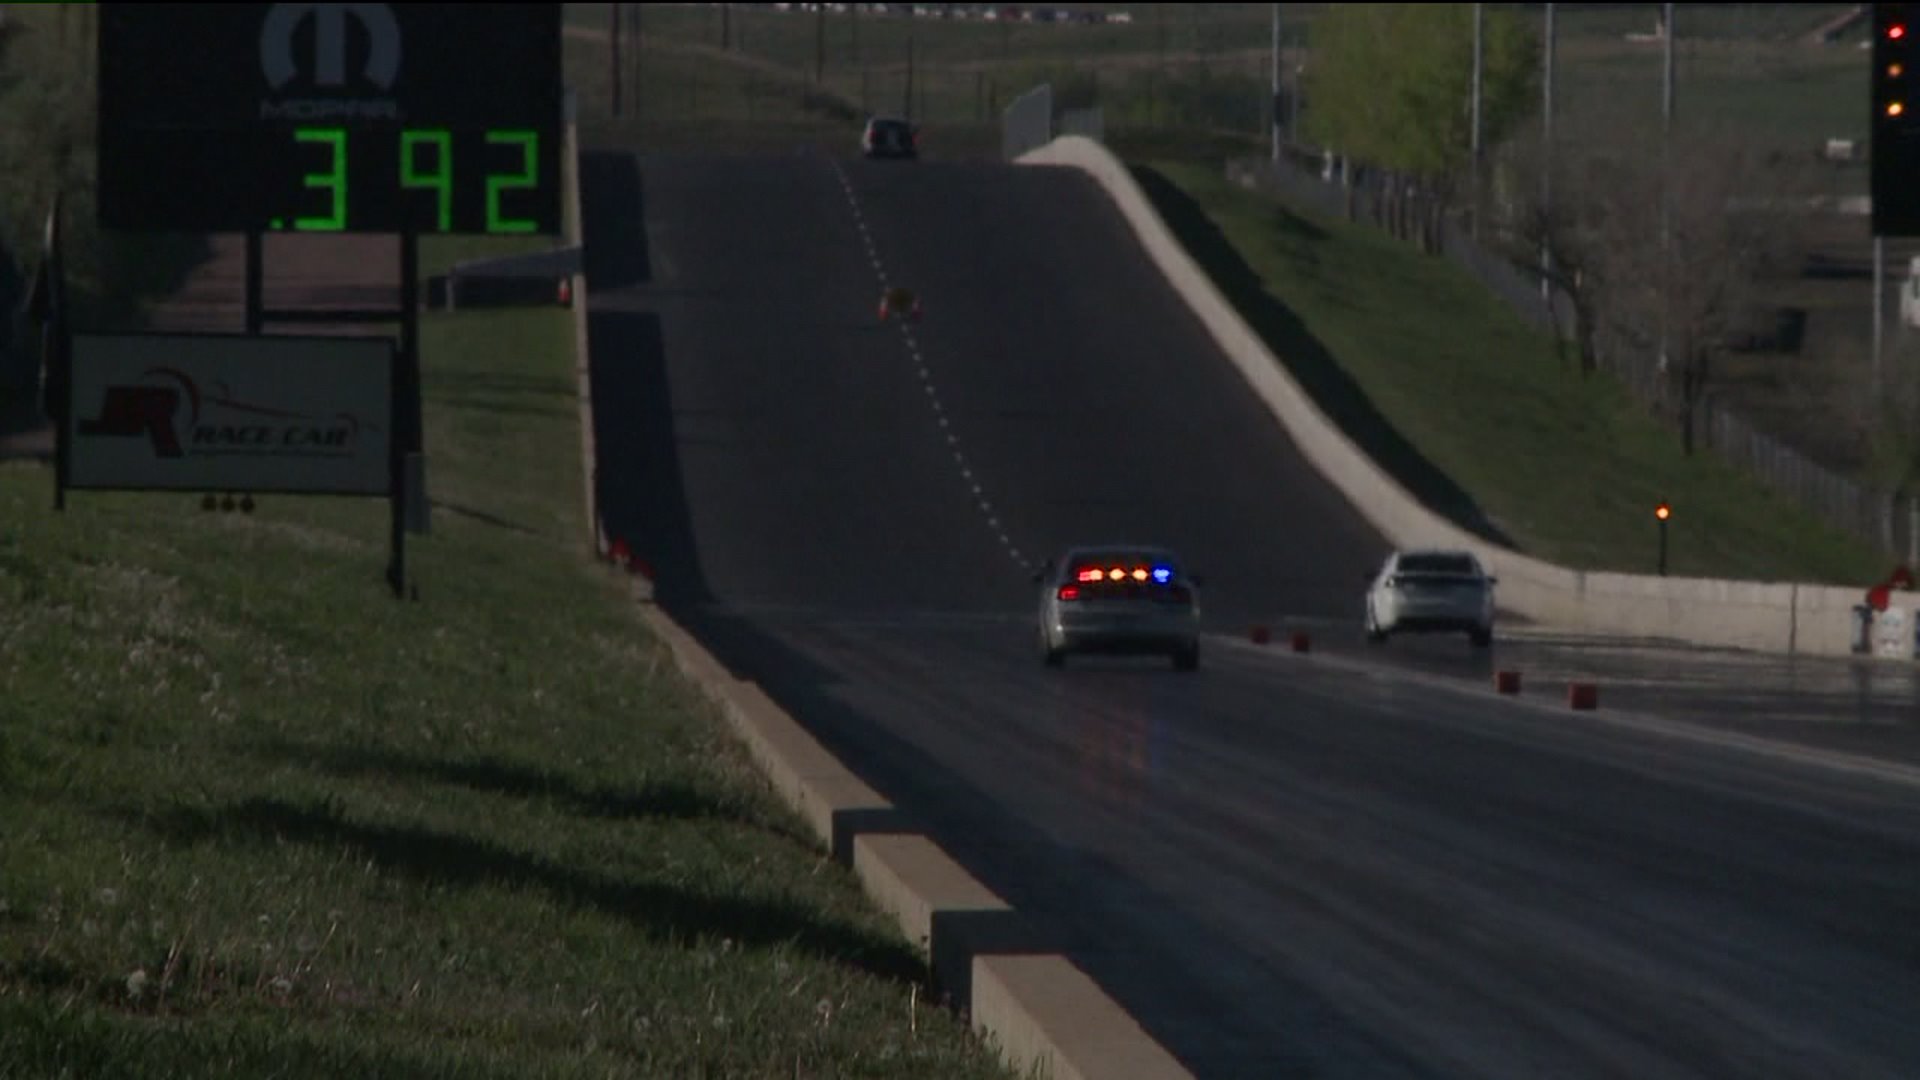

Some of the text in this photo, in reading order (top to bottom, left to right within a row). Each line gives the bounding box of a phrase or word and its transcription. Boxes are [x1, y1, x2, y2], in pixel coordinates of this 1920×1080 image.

[261, 99, 400, 120] MOPAR
[192, 425, 349, 447] RACE CAR
